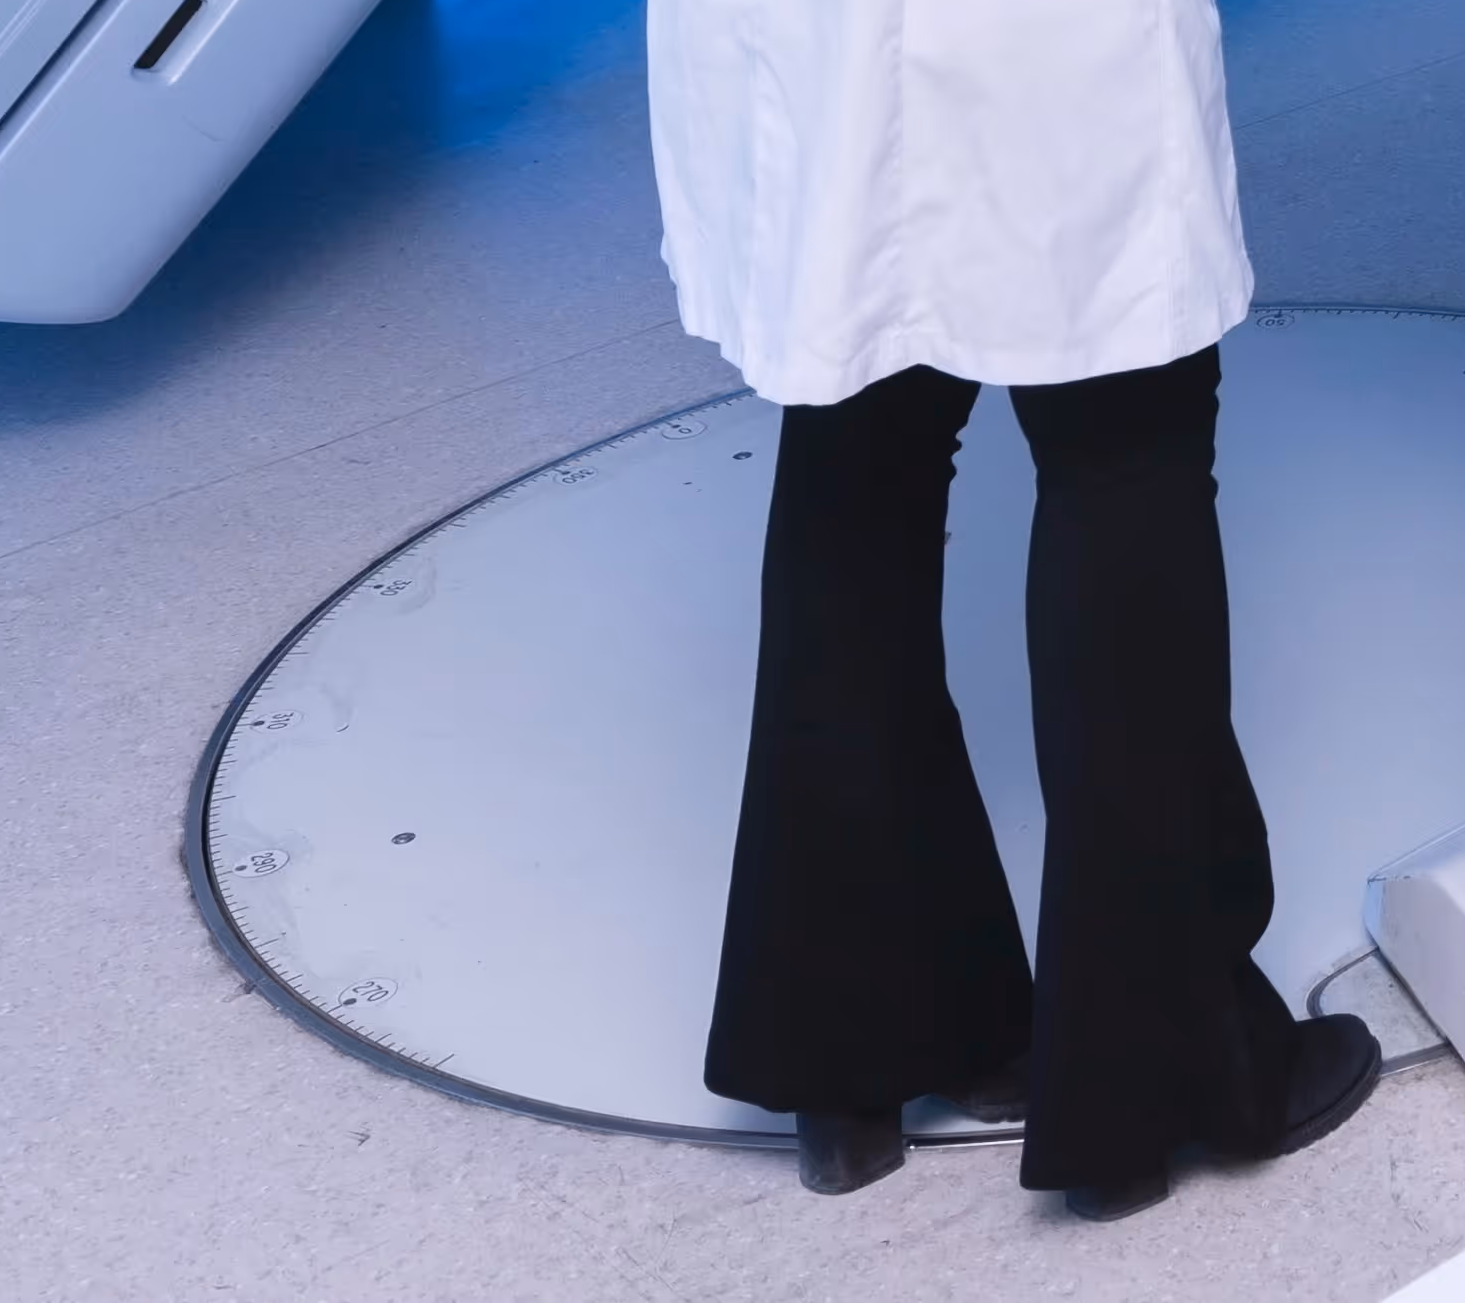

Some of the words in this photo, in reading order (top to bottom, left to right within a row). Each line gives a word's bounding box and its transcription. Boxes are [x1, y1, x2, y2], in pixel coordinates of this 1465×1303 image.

[266, 712, 294, 730] 310
[251, 852, 277, 873] 290
[352, 981, 389, 1002] 270
